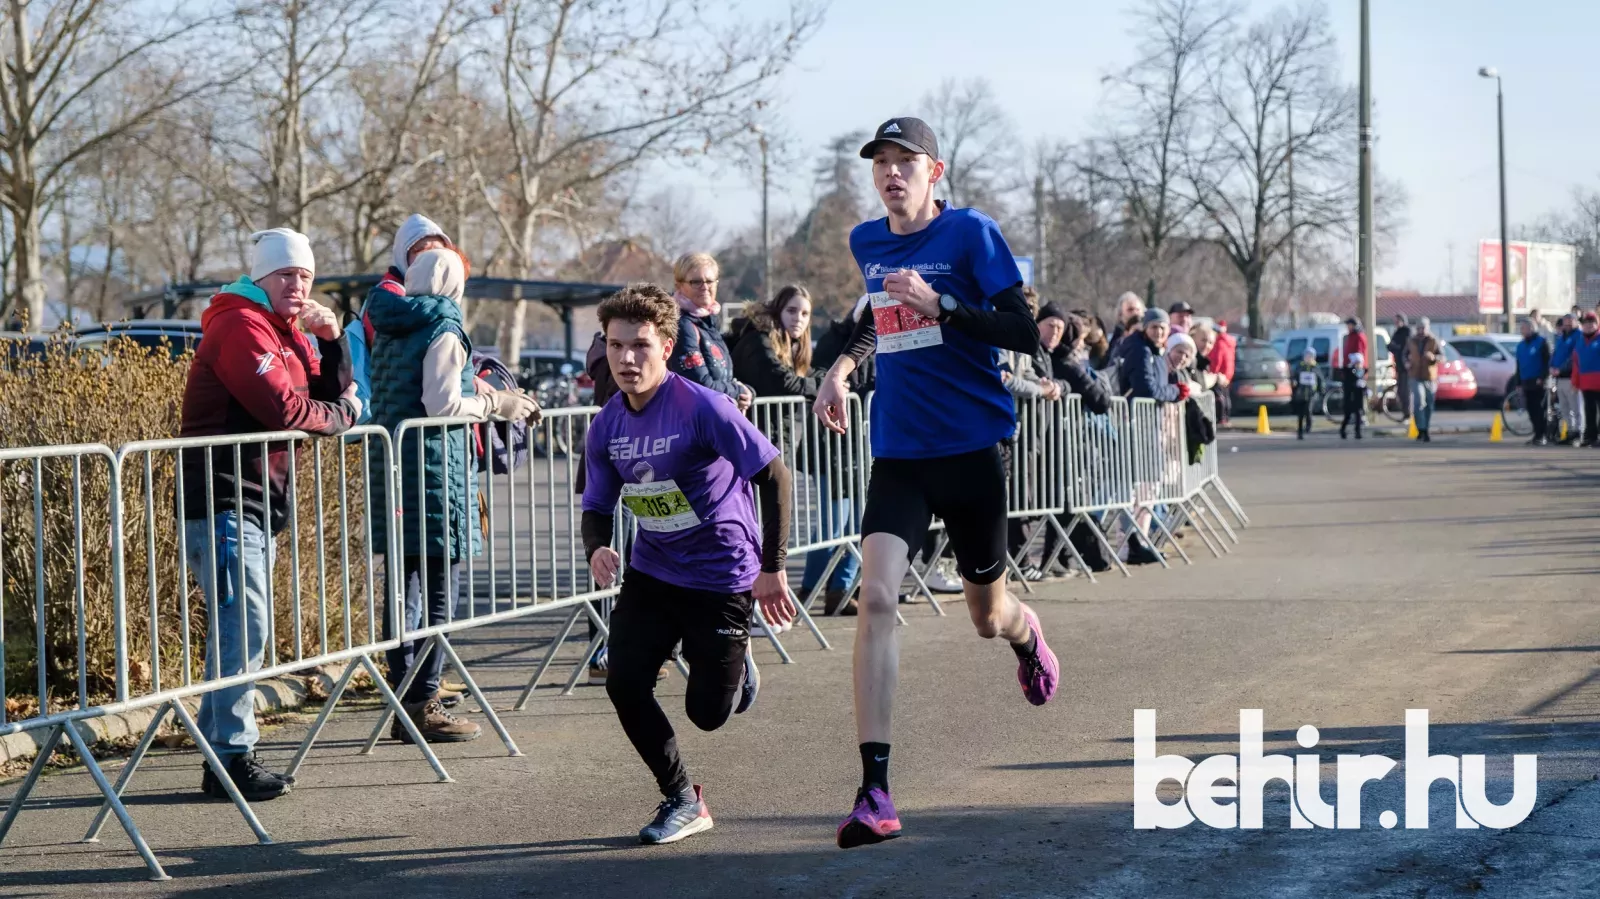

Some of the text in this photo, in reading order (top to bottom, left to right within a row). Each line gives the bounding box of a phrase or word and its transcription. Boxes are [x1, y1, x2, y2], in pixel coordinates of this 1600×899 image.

[935, 262, 951, 270] Club
[607, 433, 680, 460] saller
[642, 496, 671, 517] 315
